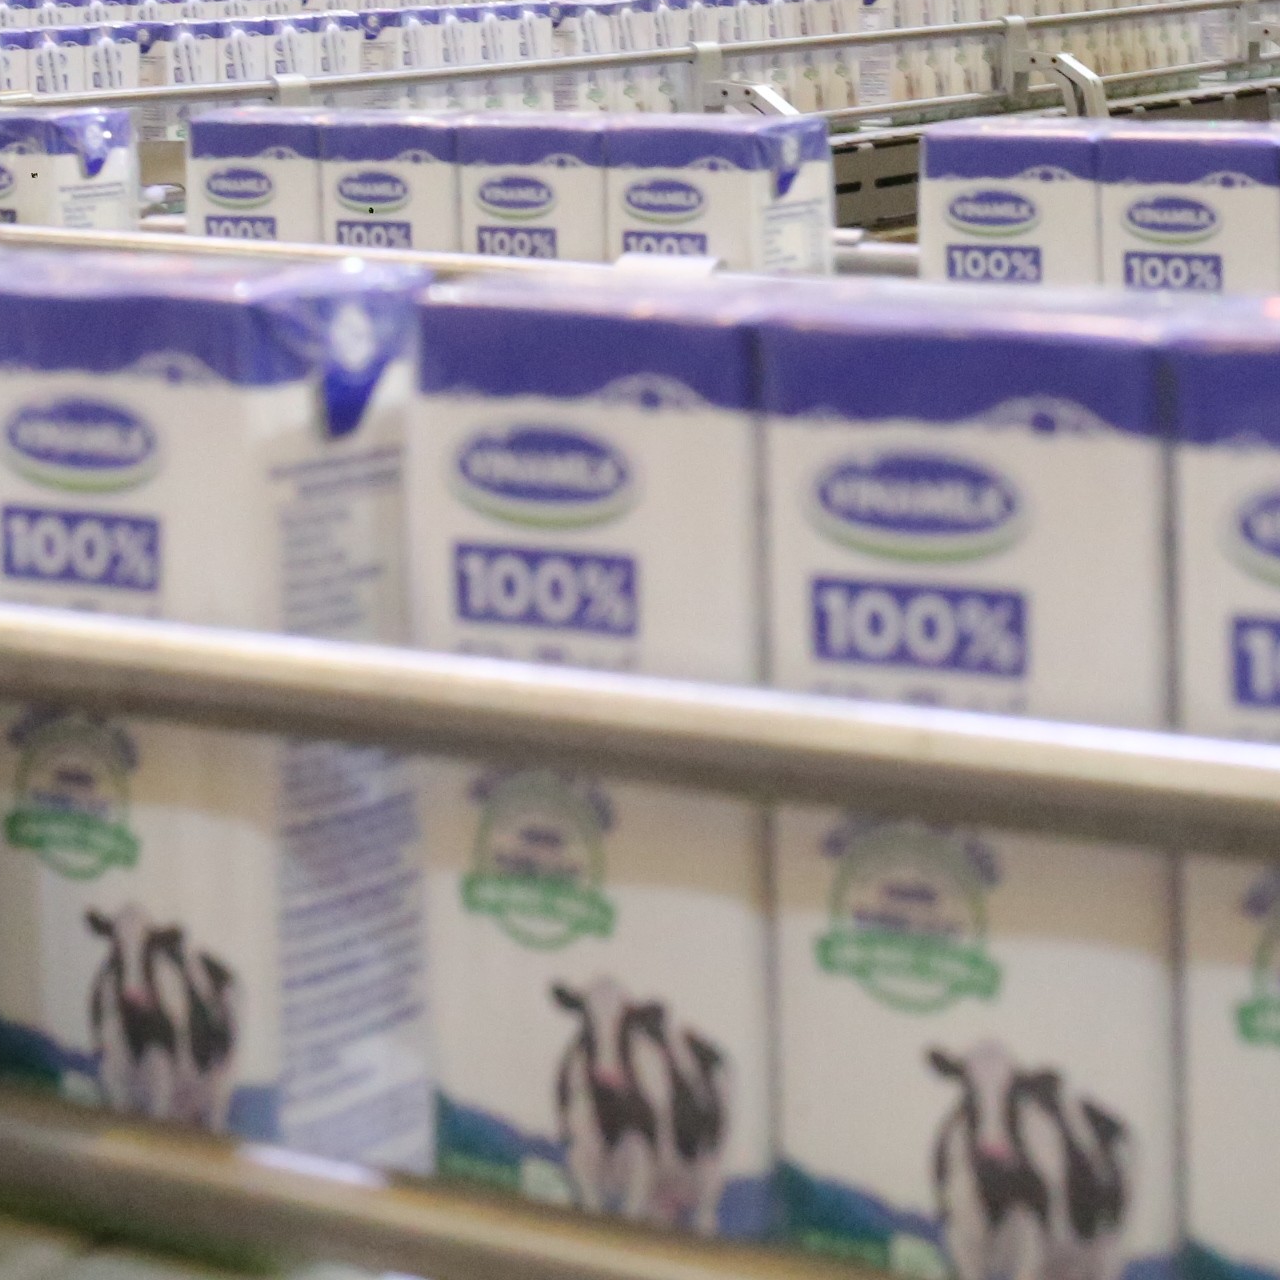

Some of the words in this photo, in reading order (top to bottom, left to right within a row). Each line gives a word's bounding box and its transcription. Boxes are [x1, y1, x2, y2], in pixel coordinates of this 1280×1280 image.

[952, 201, 1032, 219] VINAMILK
[1130, 206, 1213, 228] VINAMILK
[951, 249, 1039, 281] 100%
[1130, 255, 1220, 289] 100%
[8, 515, 155, 585] 100%
[460, 553, 632, 632] 100%
[822, 588, 1021, 674] 100%
